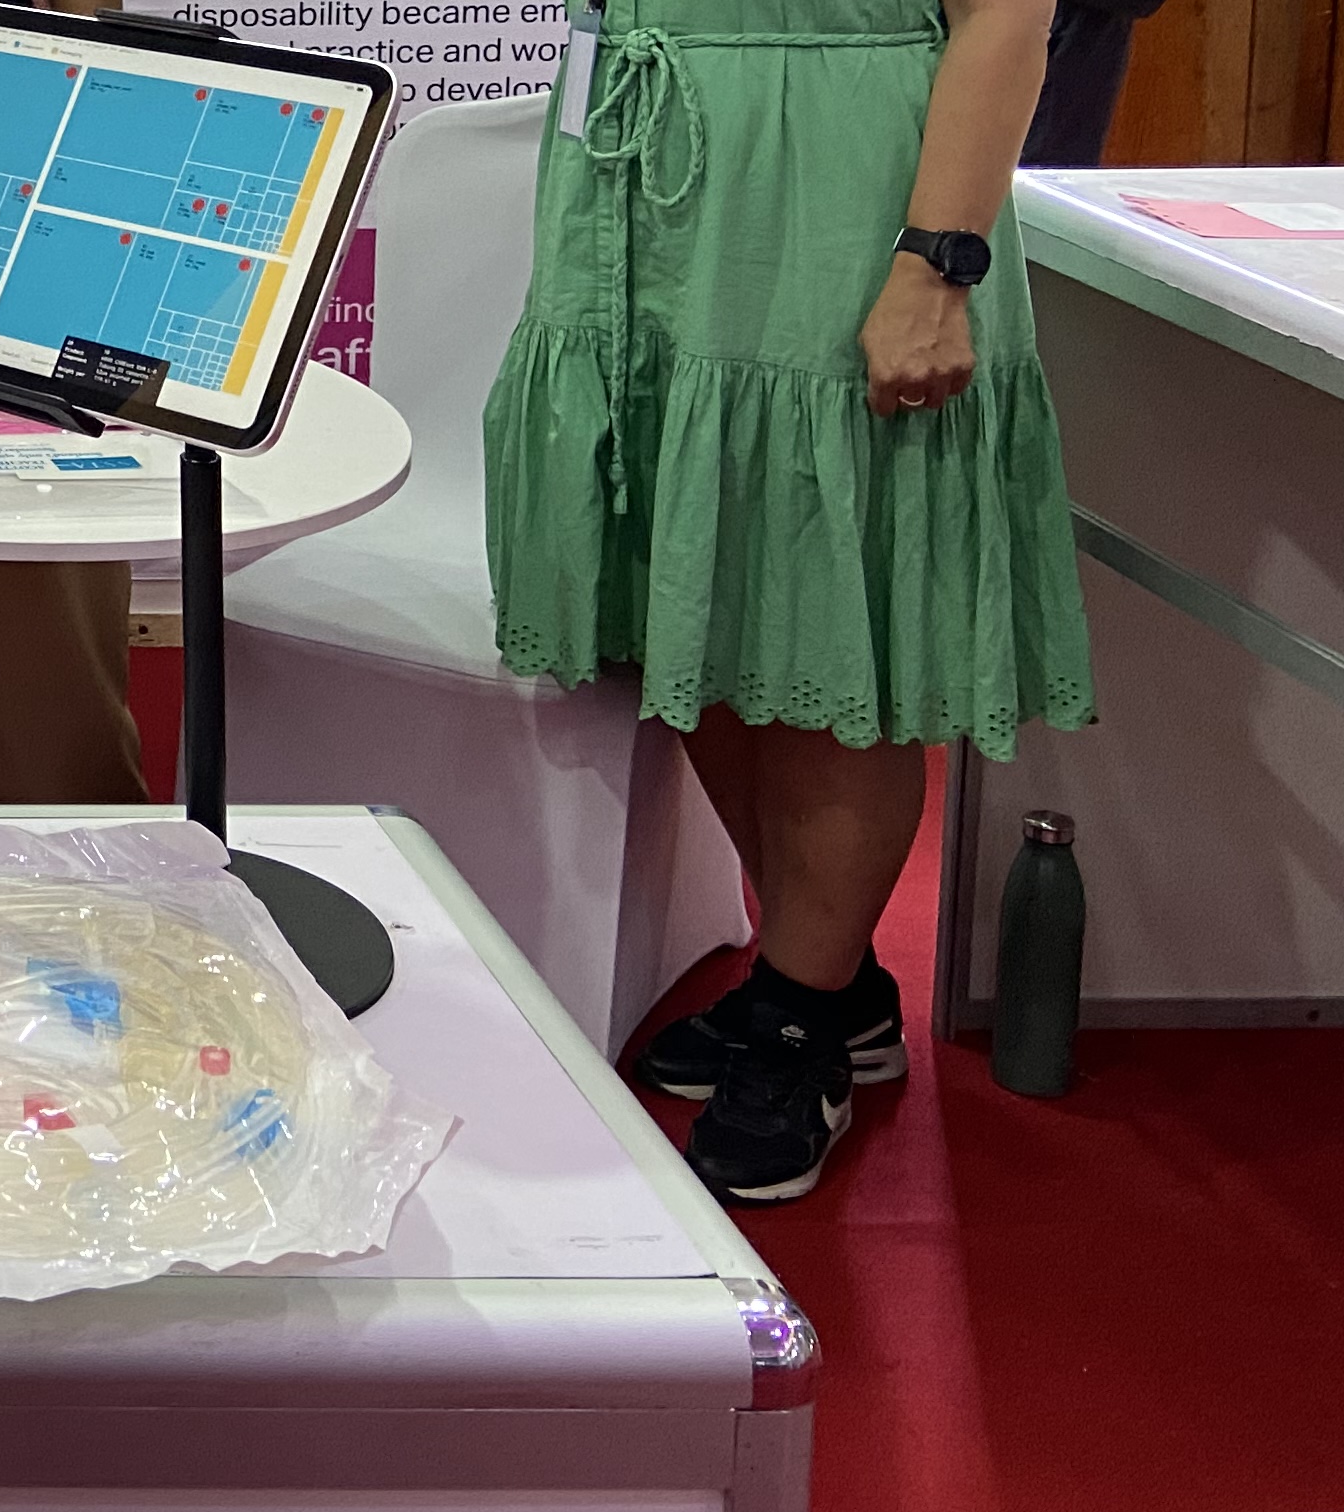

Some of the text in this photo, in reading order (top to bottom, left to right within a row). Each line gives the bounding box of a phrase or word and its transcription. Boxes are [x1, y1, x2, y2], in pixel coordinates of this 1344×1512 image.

[173, 2, 373, 32] disposability
[382, 2, 510, 25] became
[443, 38, 502, 63] and
